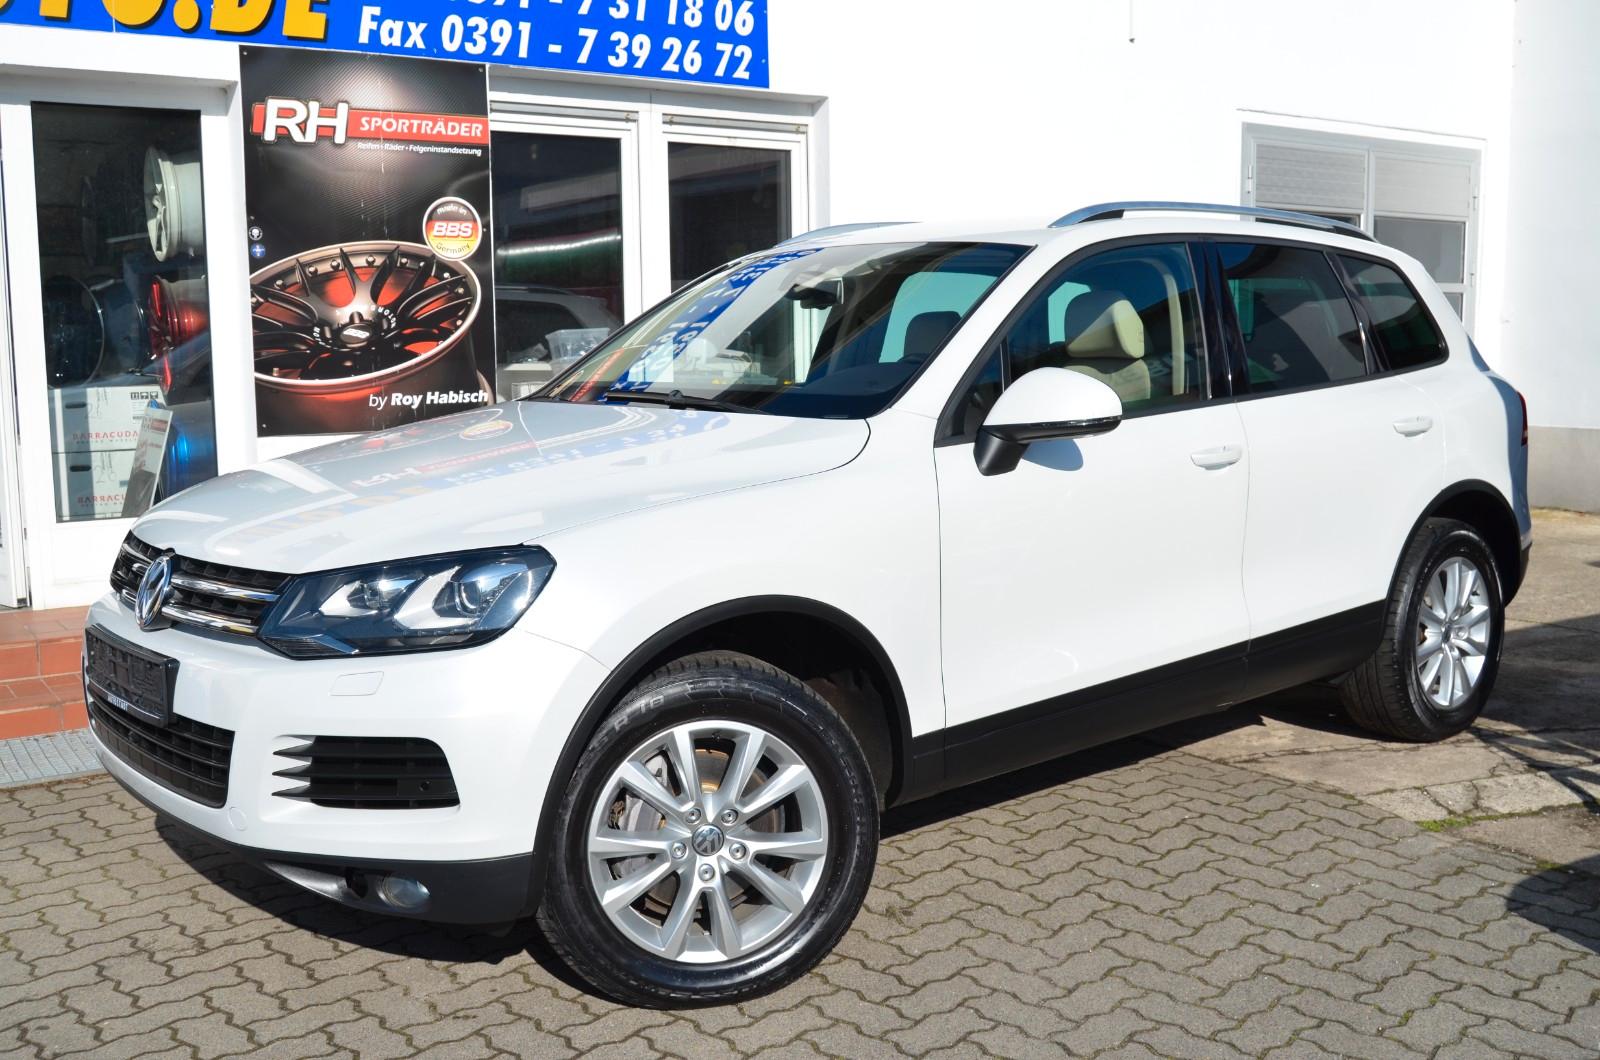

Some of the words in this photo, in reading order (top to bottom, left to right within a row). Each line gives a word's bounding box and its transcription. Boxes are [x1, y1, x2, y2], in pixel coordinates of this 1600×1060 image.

[715, 0, 755, 37] 06
[358, 6, 428, 49] Fax
[441, 14, 531, 59] 0391
[577, 27, 598, 64] 7
[608, 31, 651, 69] 39
[661, 37, 702, 75] 26
[714, 42, 753, 80] 72
[262, 97, 349, 145] RH
[360, 116, 483, 138] SPORTRÄDER
[384, 143, 405, 152] Räder
[409, 144, 482, 157] Felgeninstandsetzung
[433, 221, 473, 238] BBS
[369, 394, 387, 410] by
[391, 393, 423, 409] Roy
[426, 390, 489, 405] Habisch
